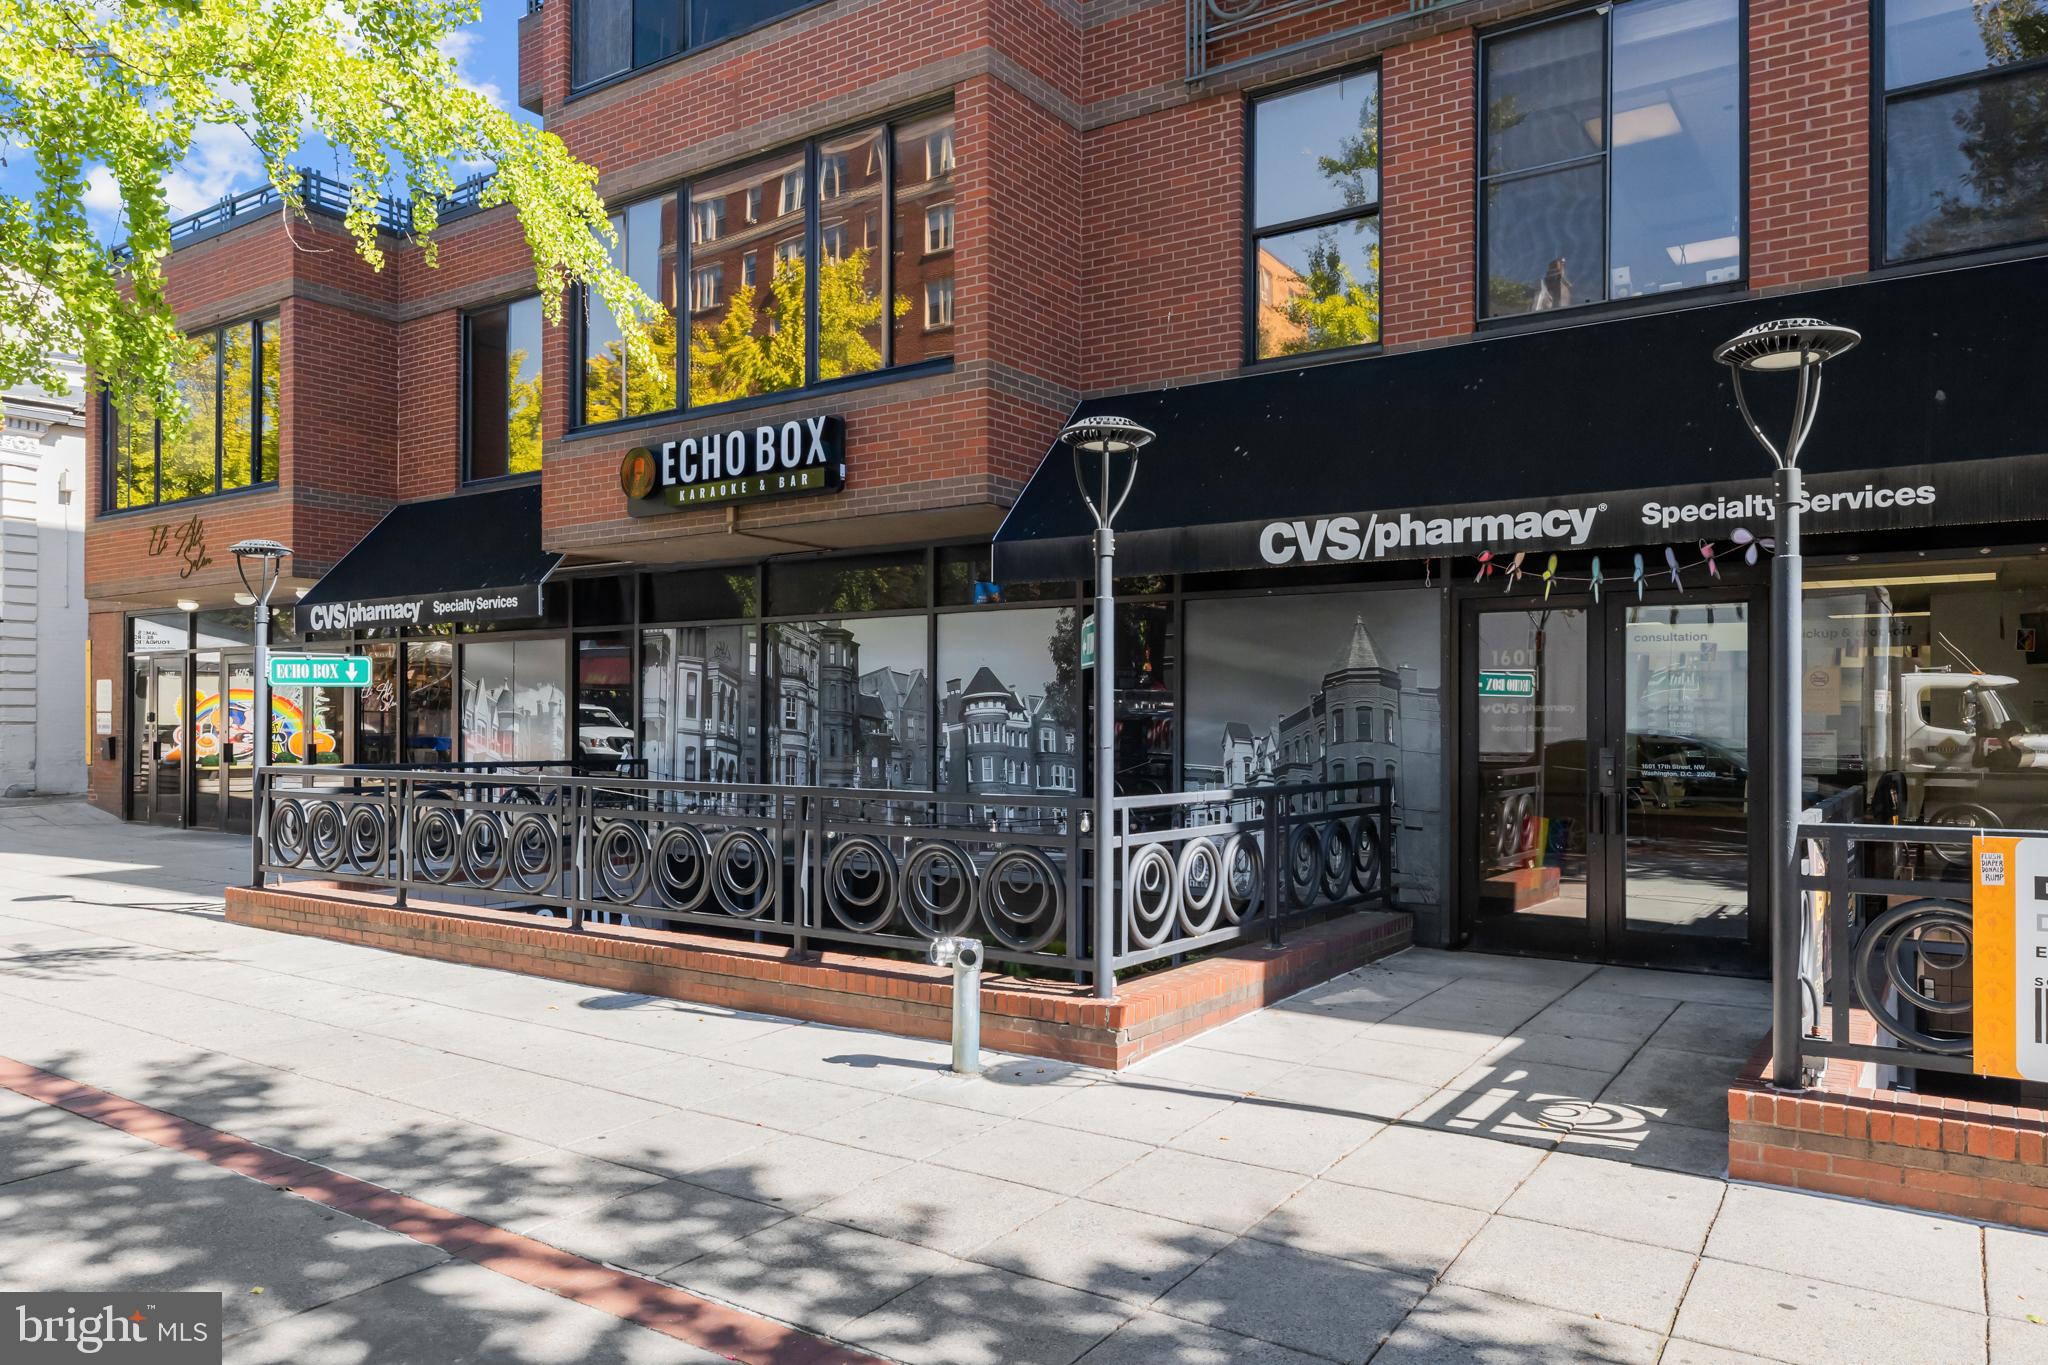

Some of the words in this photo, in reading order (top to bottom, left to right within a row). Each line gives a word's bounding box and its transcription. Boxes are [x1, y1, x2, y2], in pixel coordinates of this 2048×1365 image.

[662, 430, 746, 486] ECHO
[756, 415, 827, 472] BOX
[679, 481, 747, 502] KARAOKE
[759, 479, 766, 491] &
[778, 473, 809, 489] BAR
[1641, 494, 1775, 528] Specialty
[433, 598, 476, 615] Specialty
[476, 595, 518, 610] Services
[1634, 632, 1708, 642] consultation
[1492, 650, 1535, 666] 1601
[276, 664, 309, 679] ECHO
[313, 664, 339, 679] BOX
[1491, 703, 1519, 714] CVS
[1985, 873, 2004, 882] RUMP
